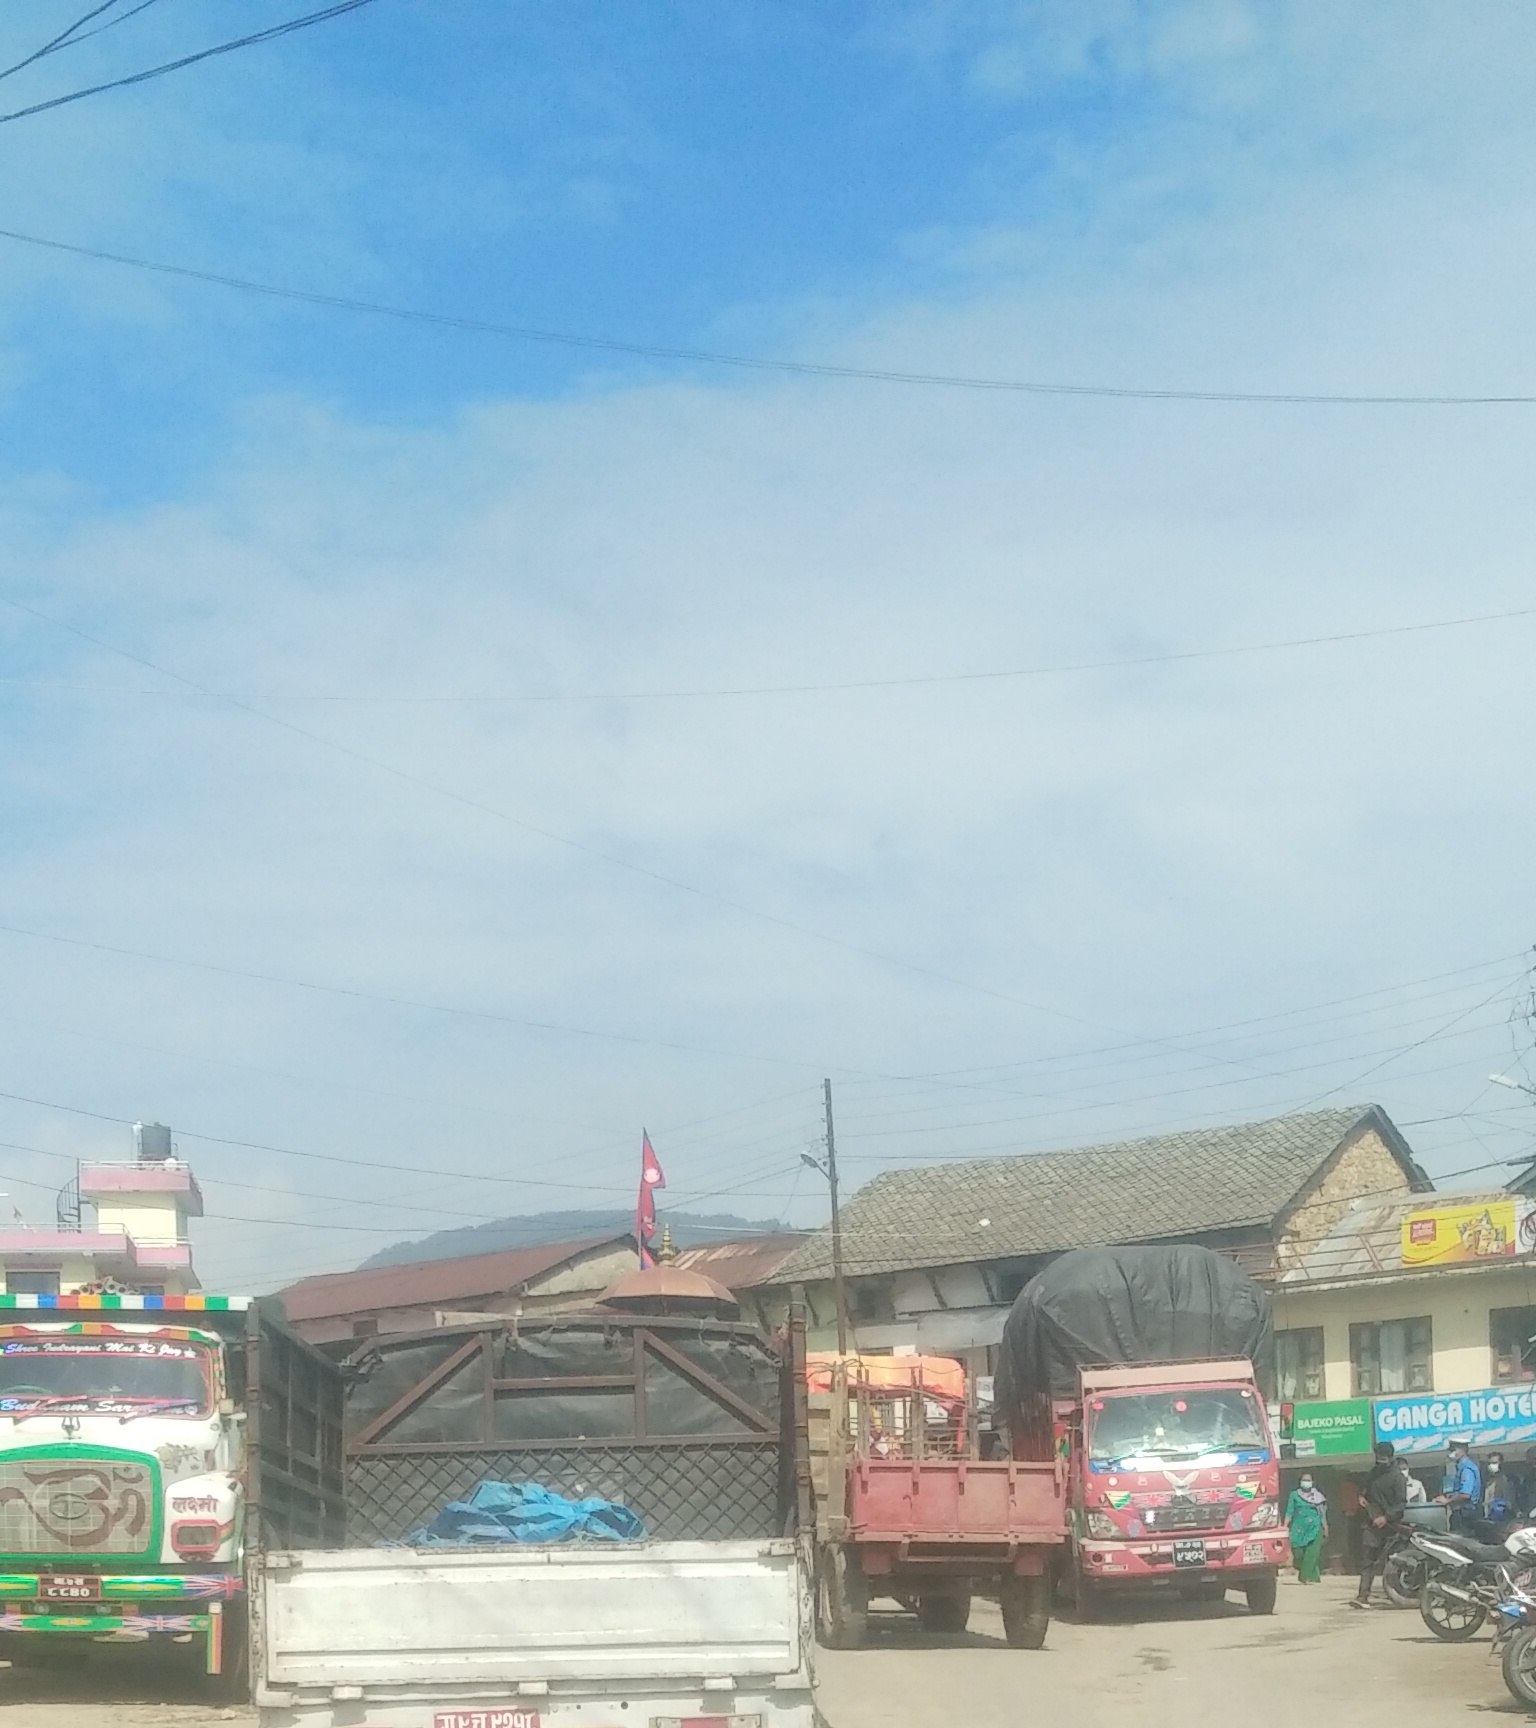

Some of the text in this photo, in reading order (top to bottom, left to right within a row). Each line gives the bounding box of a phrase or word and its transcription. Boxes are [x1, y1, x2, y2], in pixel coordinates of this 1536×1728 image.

[1297, 1415, 1364, 1430] BAJEKO PASAL
[1378, 1401, 1463, 1432] GANGA
